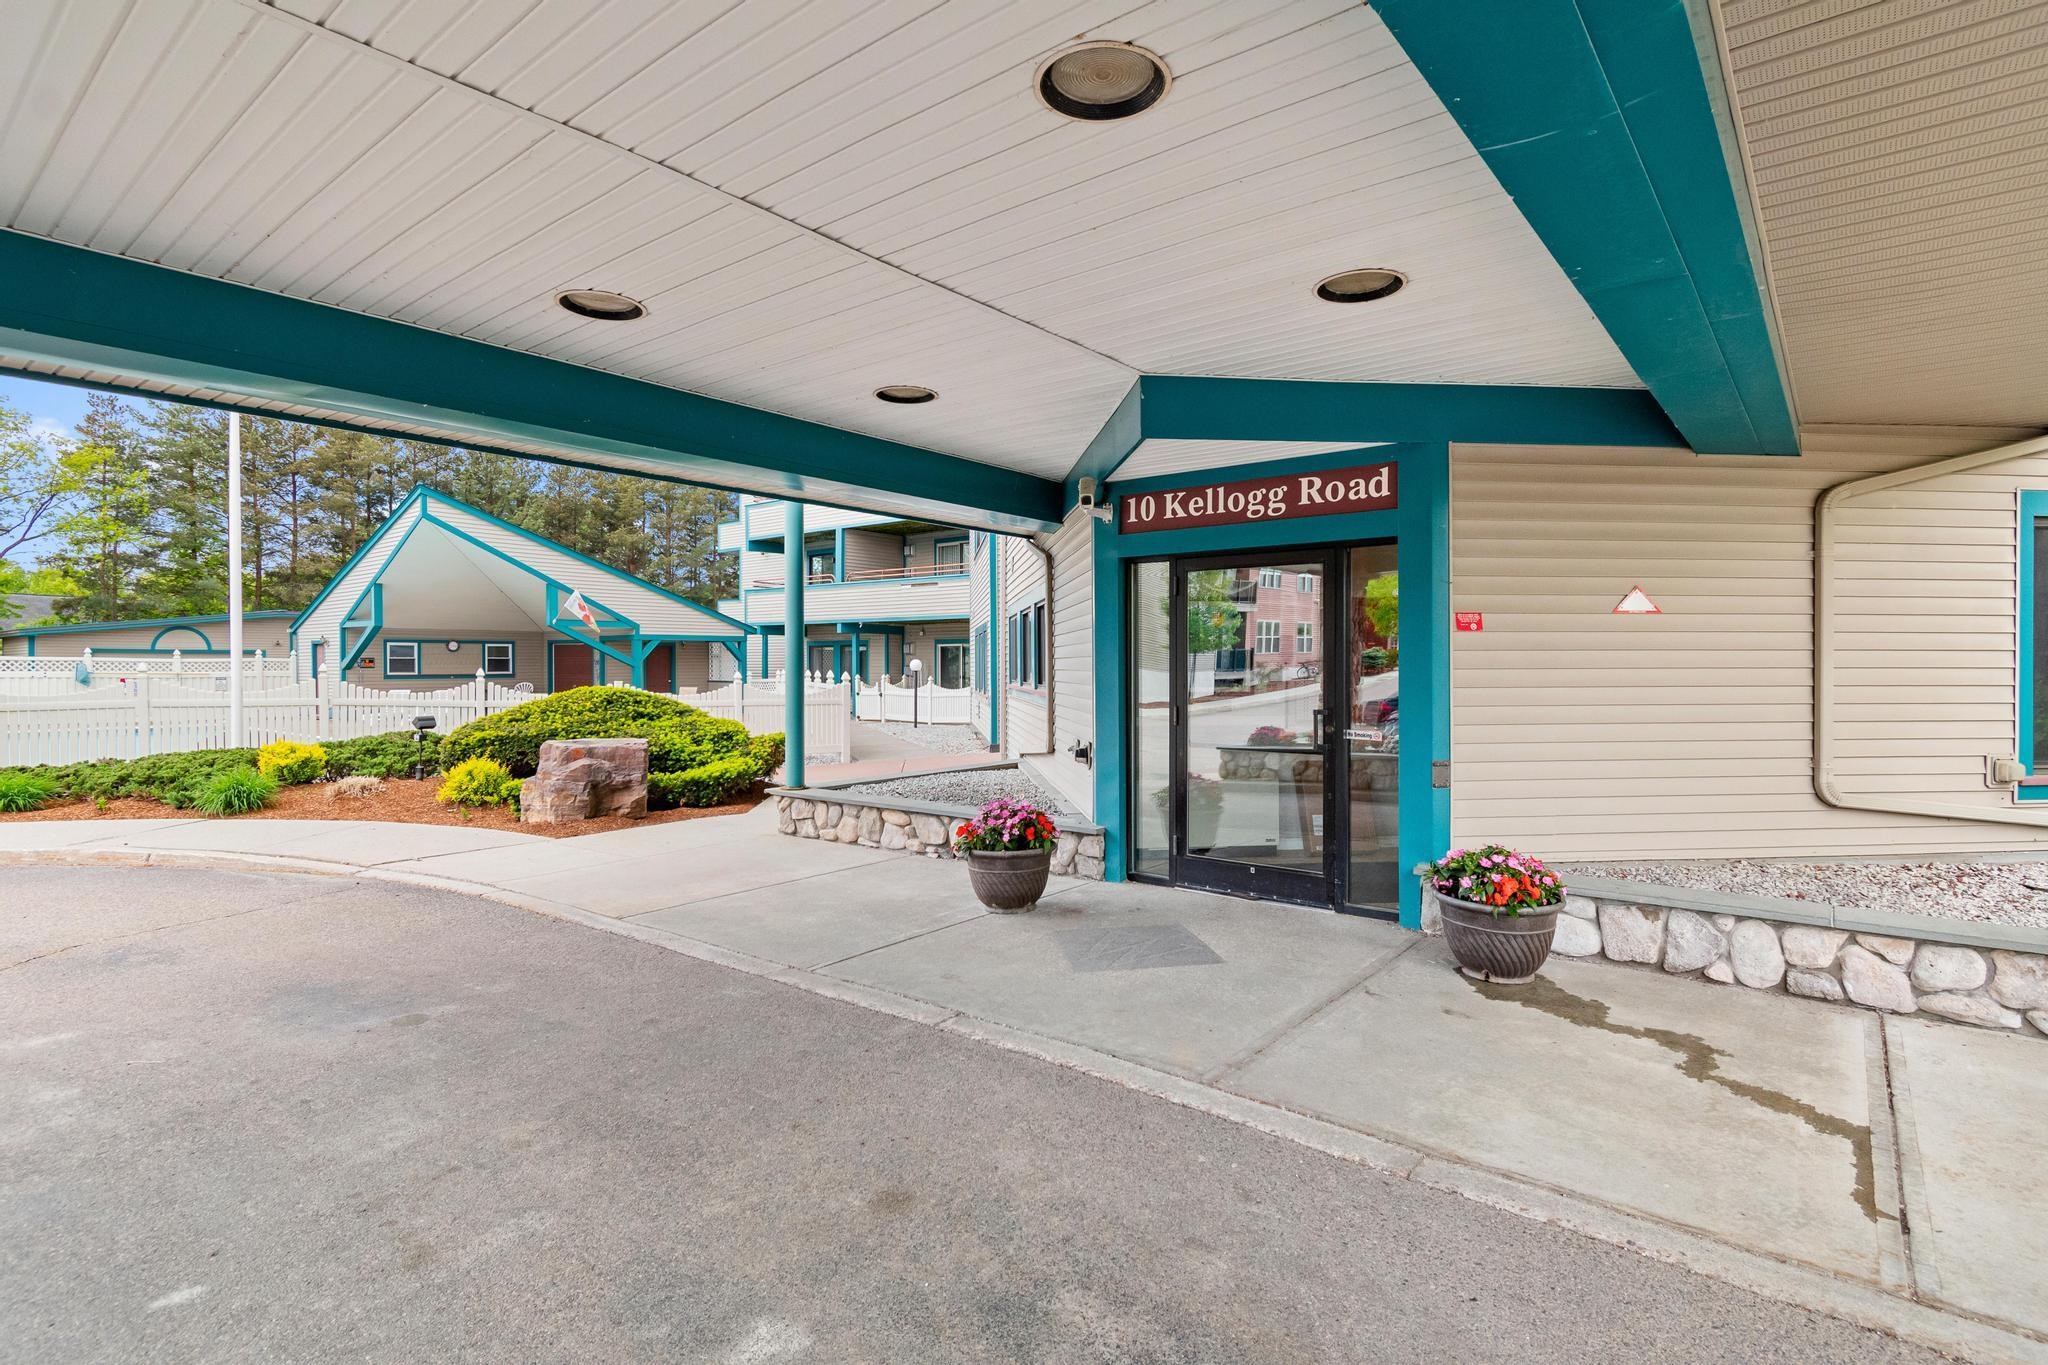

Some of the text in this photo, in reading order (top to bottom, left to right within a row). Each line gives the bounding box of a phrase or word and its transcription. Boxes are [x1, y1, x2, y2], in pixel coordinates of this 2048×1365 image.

[1127, 466, 1391, 523] 10 Kellogg Road
[1354, 731, 1373, 739] Smoking
